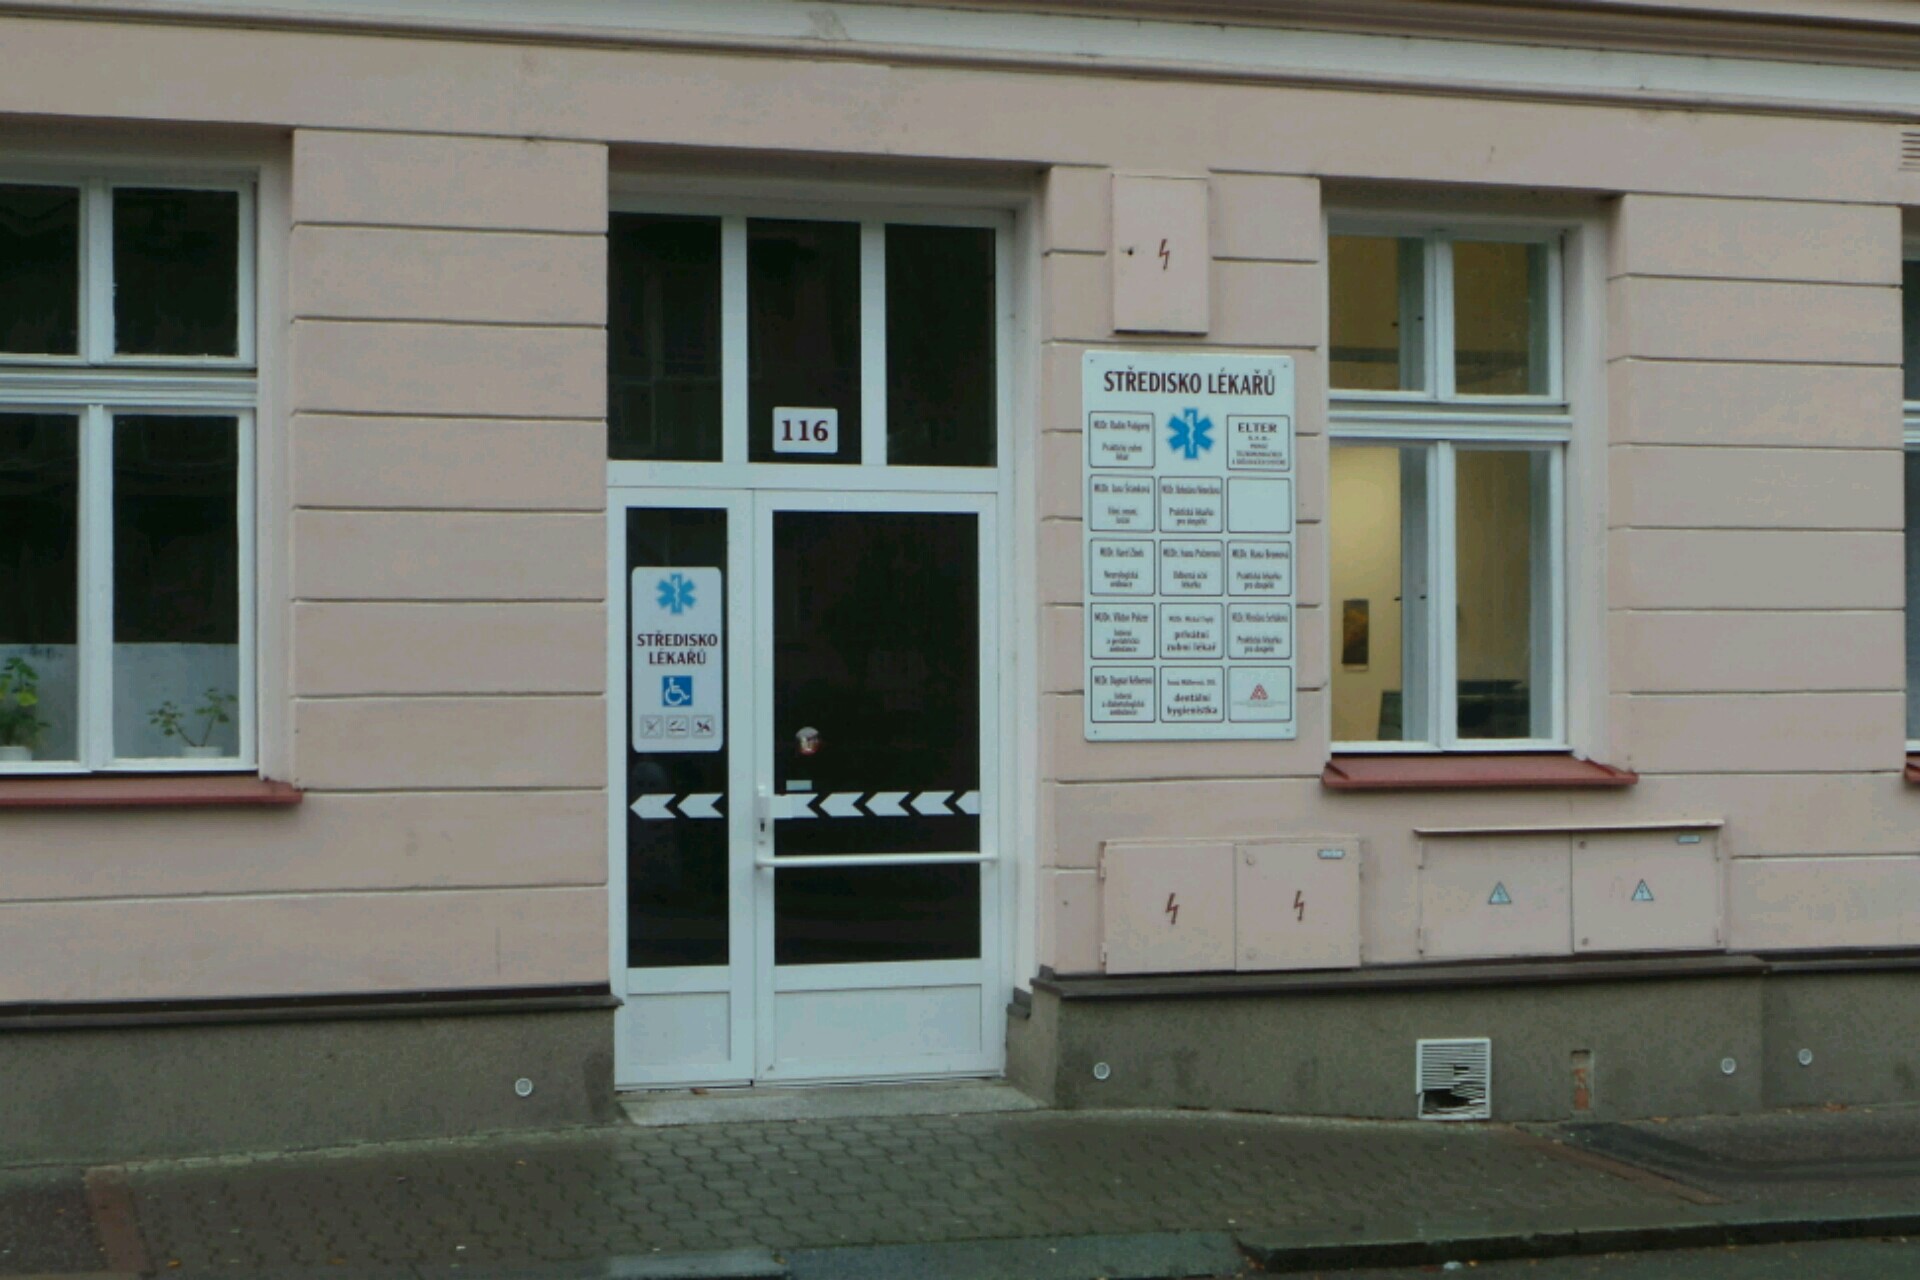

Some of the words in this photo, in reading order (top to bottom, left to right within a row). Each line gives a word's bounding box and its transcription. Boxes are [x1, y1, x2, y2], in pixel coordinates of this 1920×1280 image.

[1104, 365, 1201, 394] STŘEDISKO
[1208, 367, 1275, 396] LÉKAŘŮ
[781, 419, 829, 442] 116
[1238, 422, 1277, 433] ELTER
[637, 629, 718, 647] STŘEDISKO
[649, 648, 706, 665] LÉKAŘŮ
[1174, 692, 1211, 702] dentální
[1167, 704, 1218, 717] hygienistka
